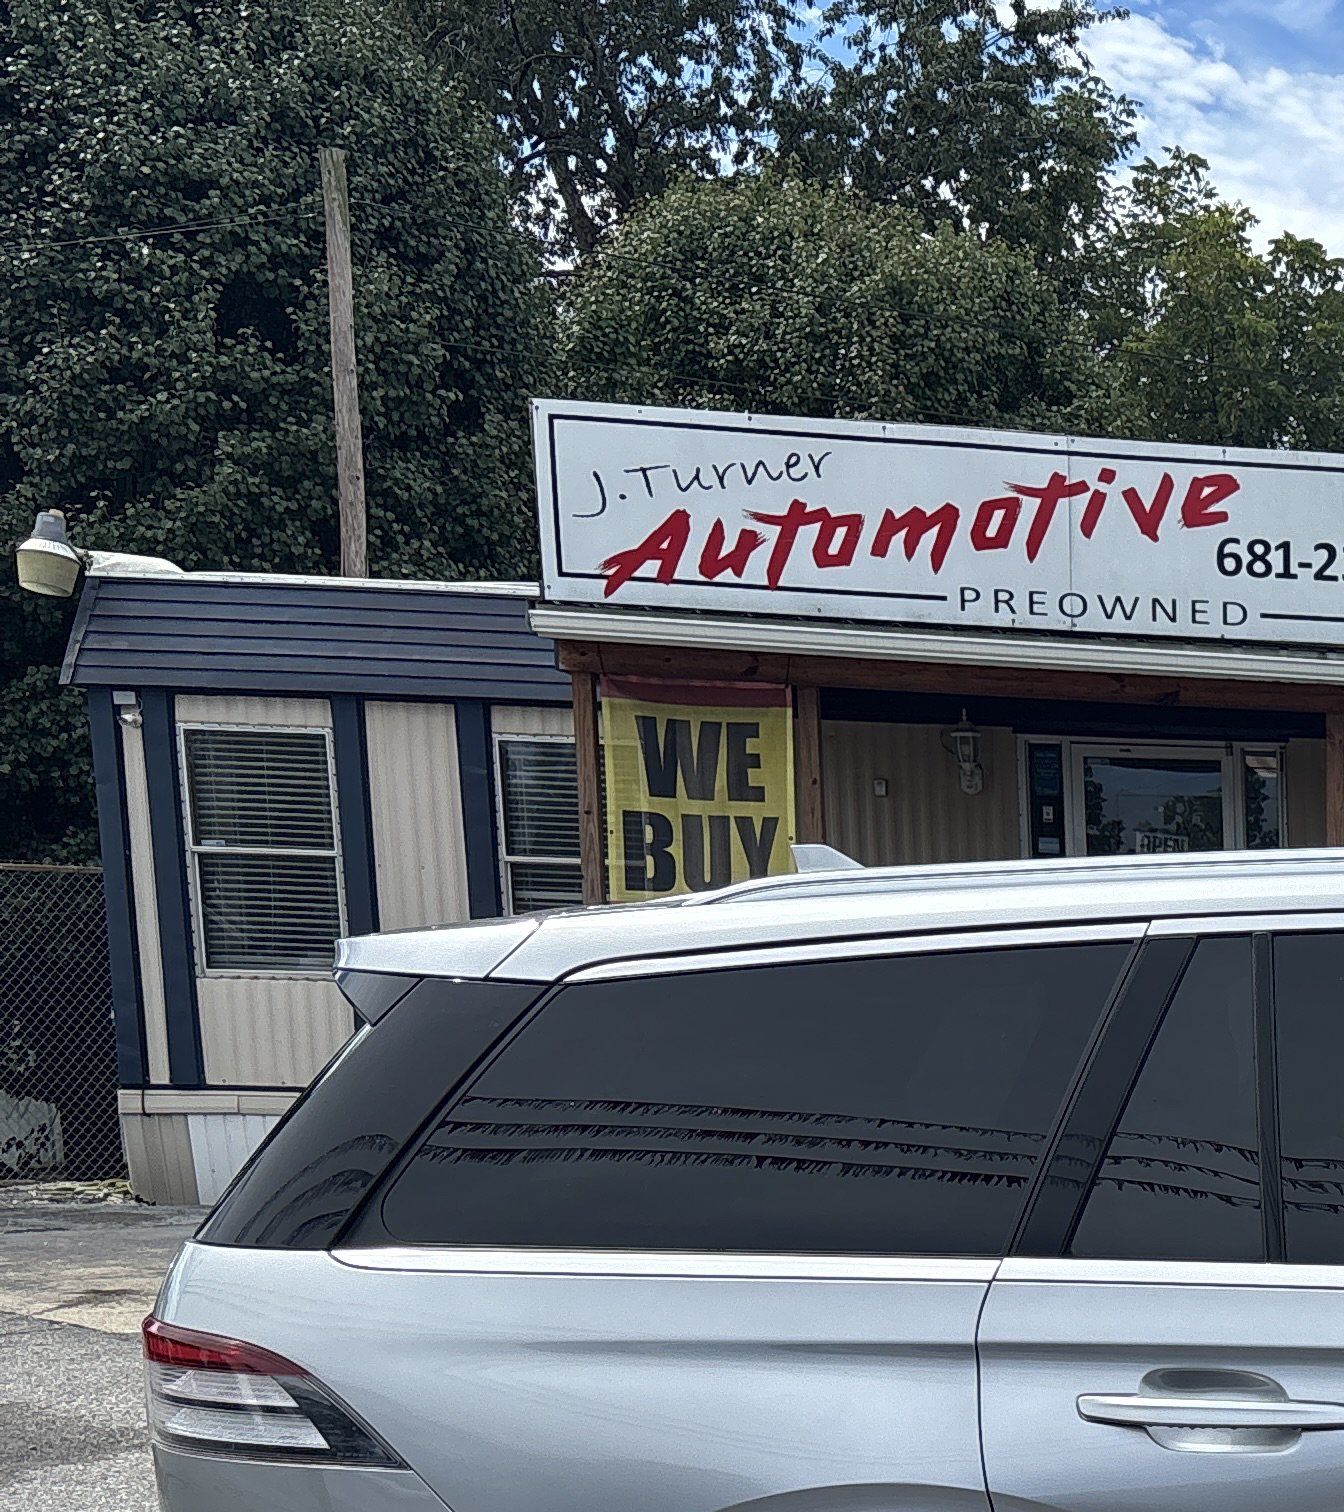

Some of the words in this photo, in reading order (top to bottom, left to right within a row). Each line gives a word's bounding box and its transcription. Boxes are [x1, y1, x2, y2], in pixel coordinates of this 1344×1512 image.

[959, 586, 1249, 627] PREOWNED
[634, 715, 766, 803] WE
[622, 810, 780, 892] BUY
